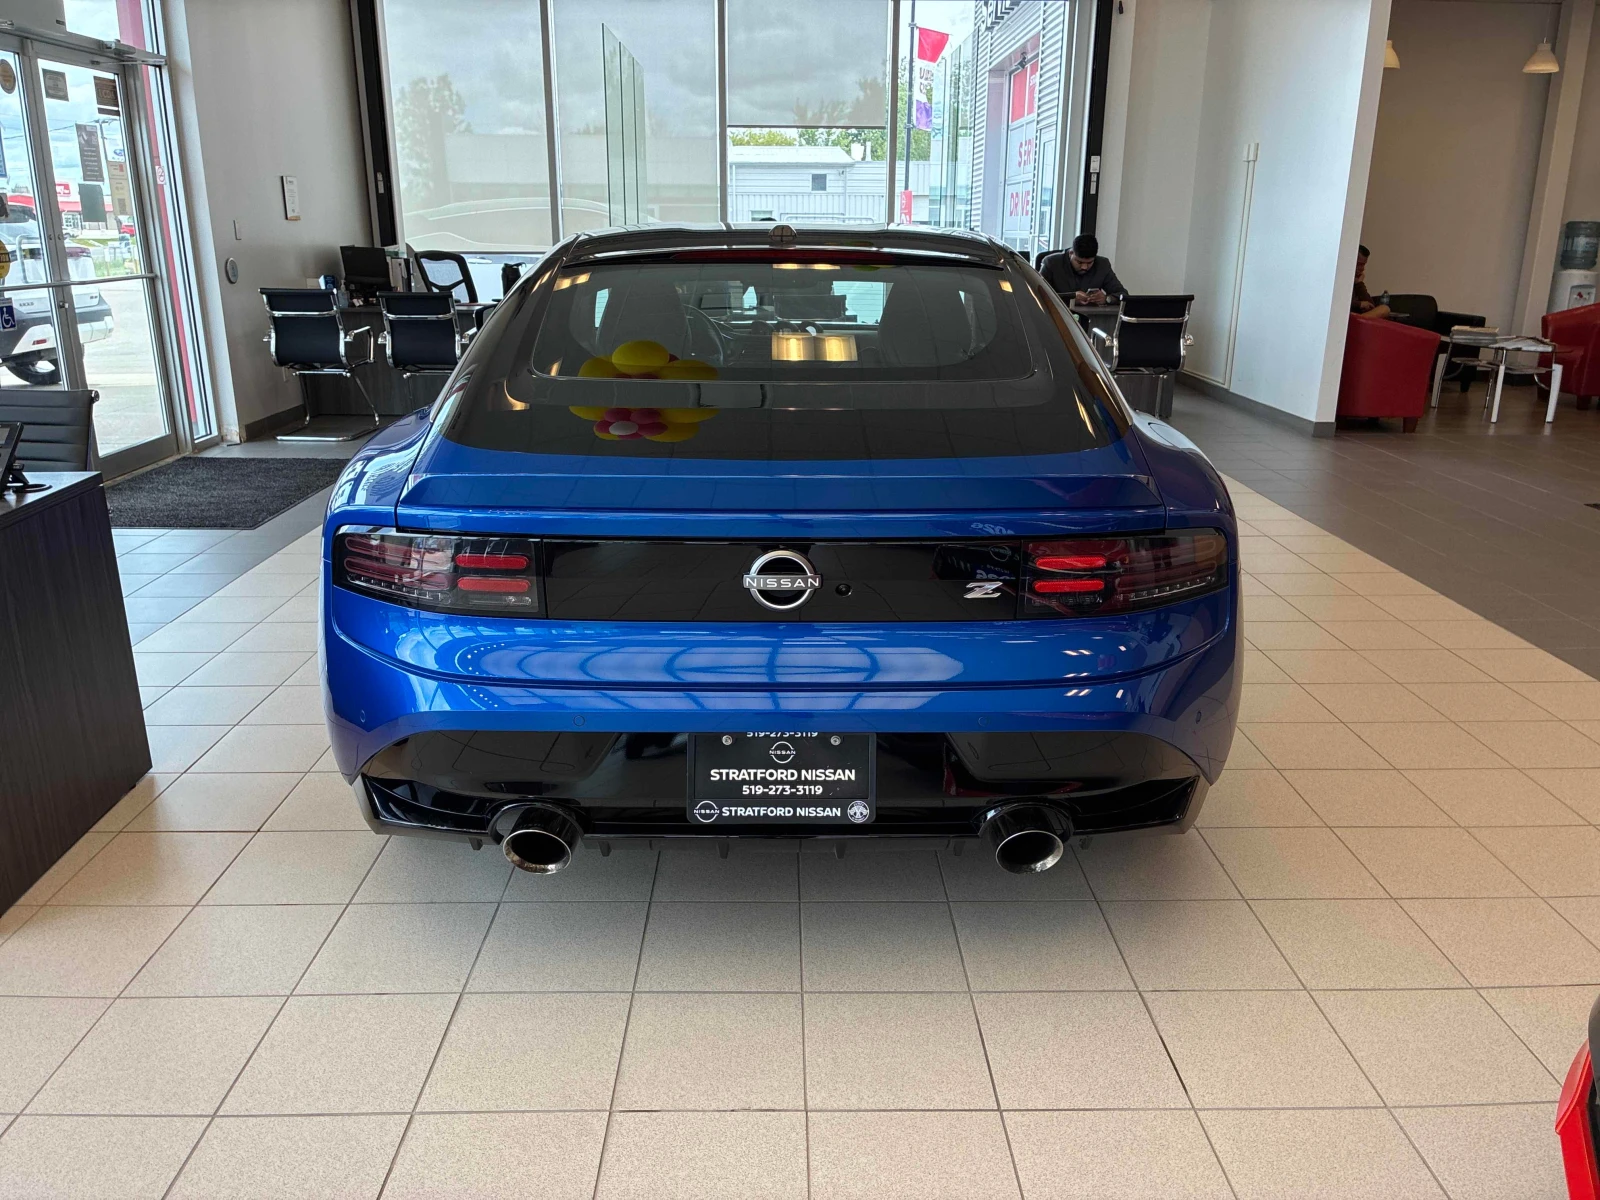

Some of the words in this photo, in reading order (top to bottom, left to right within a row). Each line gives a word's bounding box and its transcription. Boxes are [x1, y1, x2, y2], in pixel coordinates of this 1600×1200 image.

[1010, 190, 1030, 216] DRVE
[745, 577, 819, 588] NISSAN
[963, 581, 1003, 598] Z
[710, 769, 798, 781] STRATFORD
[801, 769, 855, 781] NISSAN
[742, 785, 823, 795] 519-273-3119
[722, 807, 793, 817] STRATFORD
[796, 807, 841, 817] NISSAN
